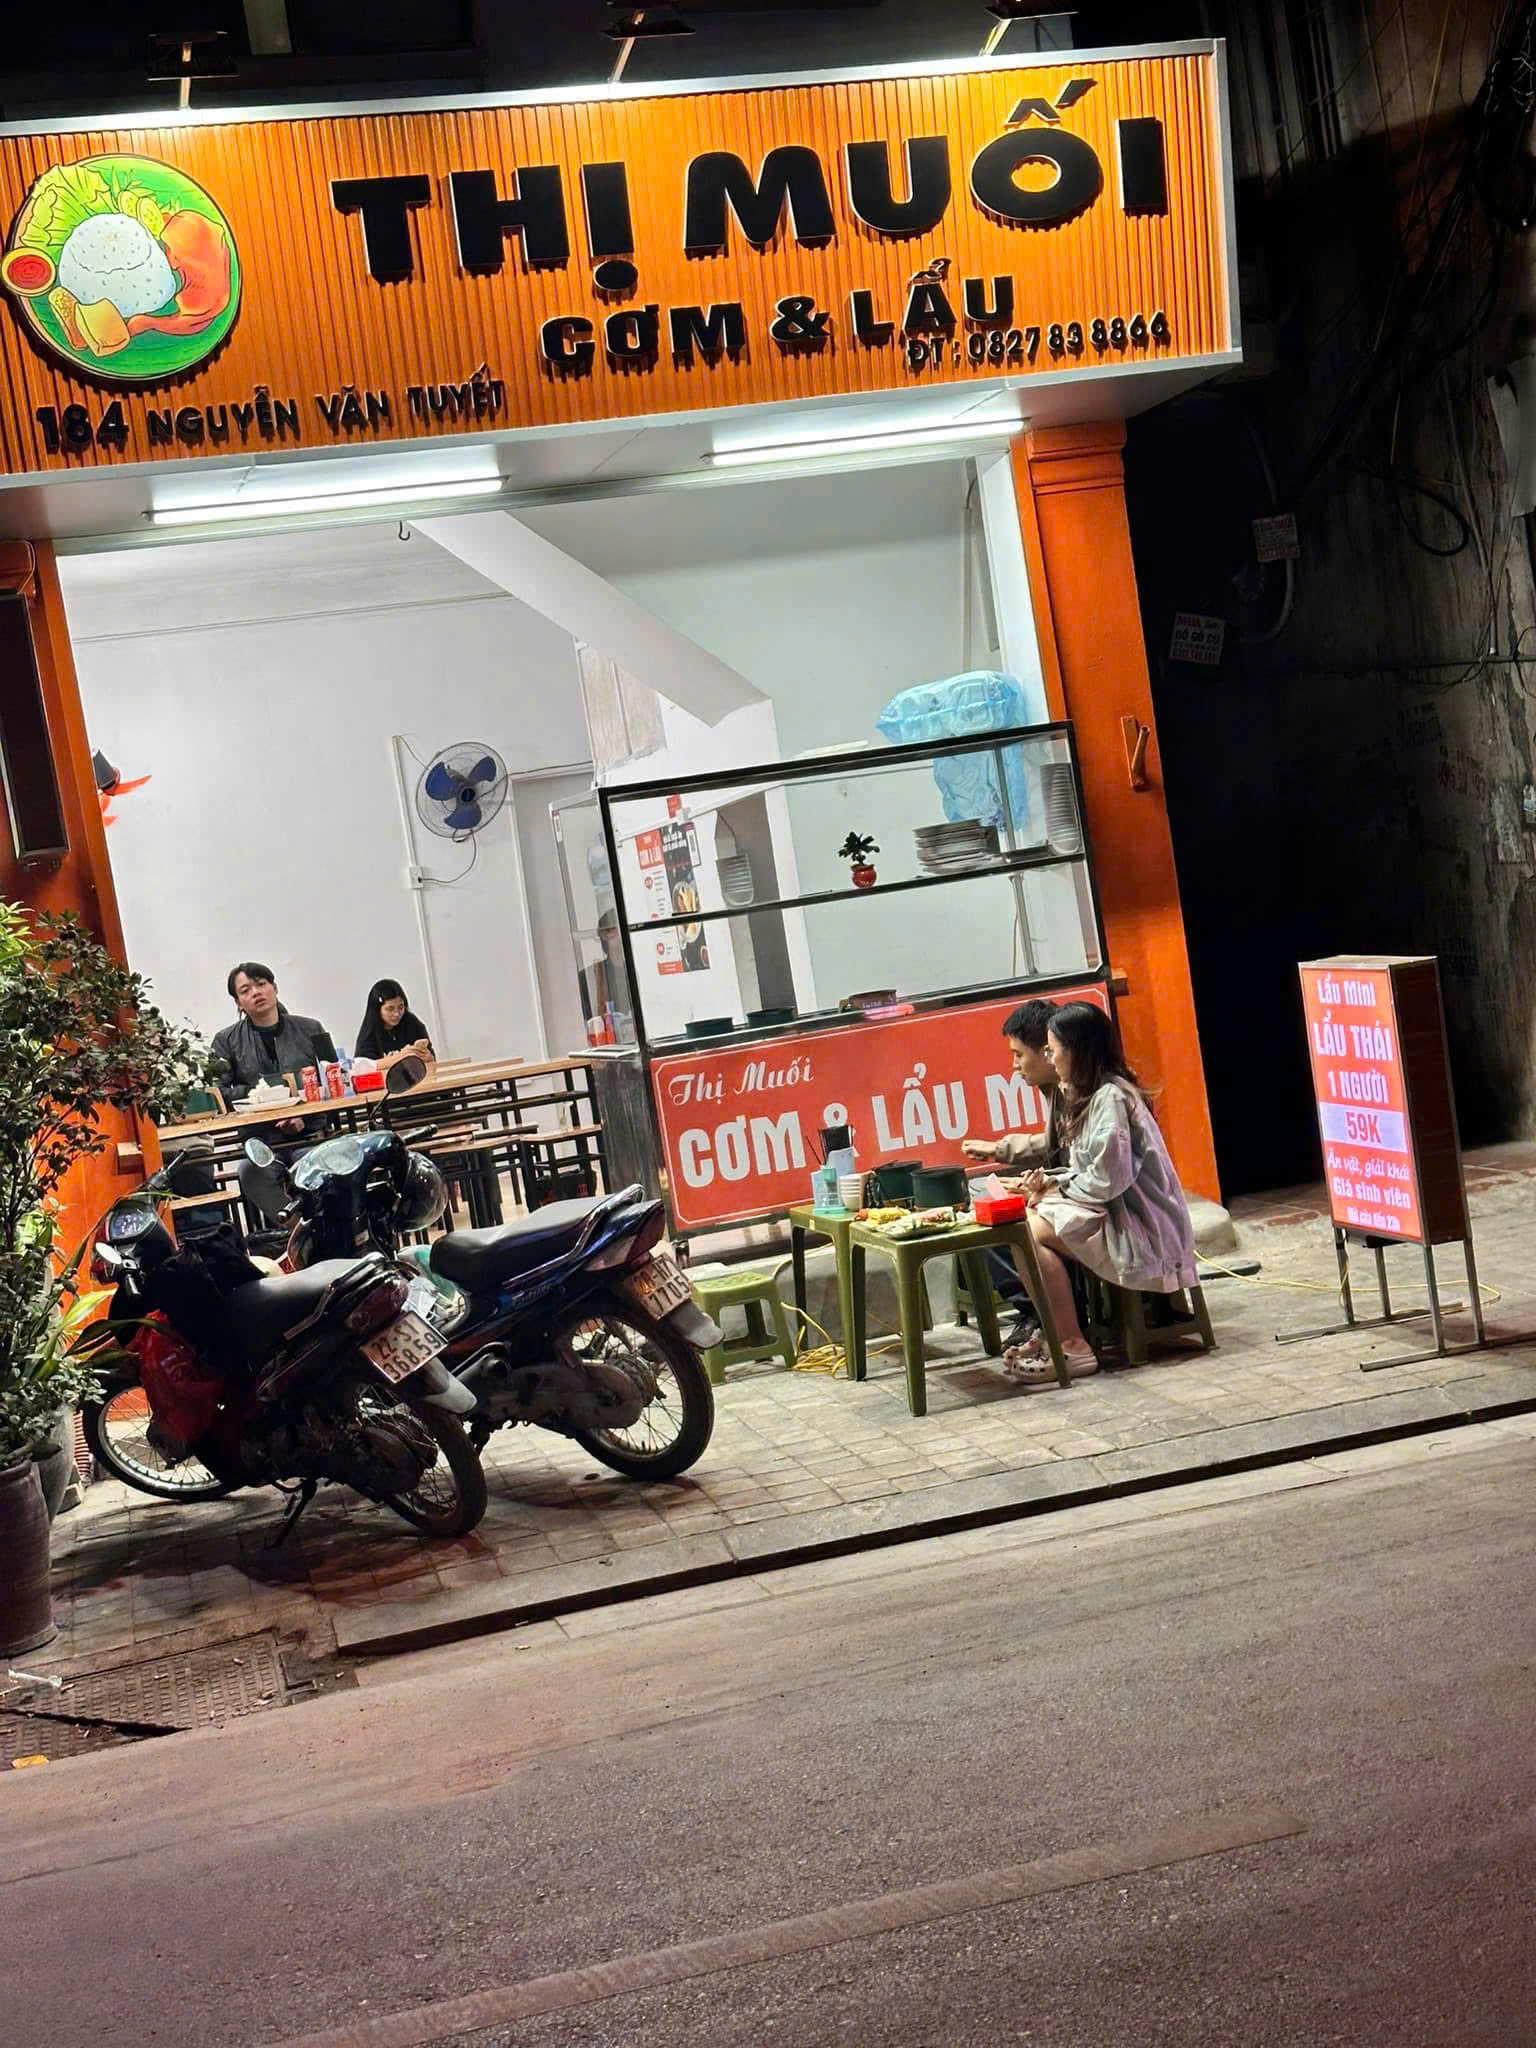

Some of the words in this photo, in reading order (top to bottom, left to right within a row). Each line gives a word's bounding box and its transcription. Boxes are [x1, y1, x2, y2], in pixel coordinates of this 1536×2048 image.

[331, 161, 639, 298] THỊ
[684, 79, 1168, 256] MUỐI
[540, 302, 744, 364] CƠM
[769, 296, 830, 344] &
[850, 257, 1014, 337] LẨU
[968, 326, 1041, 360] 0827
[1048, 321, 1084, 351] 83
[1091, 311, 1170, 346] 8866
[36, 400, 130, 455] 184
[147, 384, 300, 440] NGUYỄN
[314, 384, 392, 427] VĂN
[406, 361, 505, 417] TUYẾT
[1317, 972, 1341, 1004] Lẩu
[1313, 1009, 1347, 1057] LẨU
[1350, 1020, 1393, 1062] THÁI
[668, 1073, 726, 1105] Thị
[734, 1056, 815, 1095] Muối
[1328, 1070, 1337, 1097] 1
[1339, 1068, 1389, 1104] NGƯỜI
[679, 1110, 807, 1188] CƠM
[871, 1062, 969, 1153] LẨU
[1345, 1111, 1382, 1143] 59K
[648, 1275, 690, 1312] 7705
